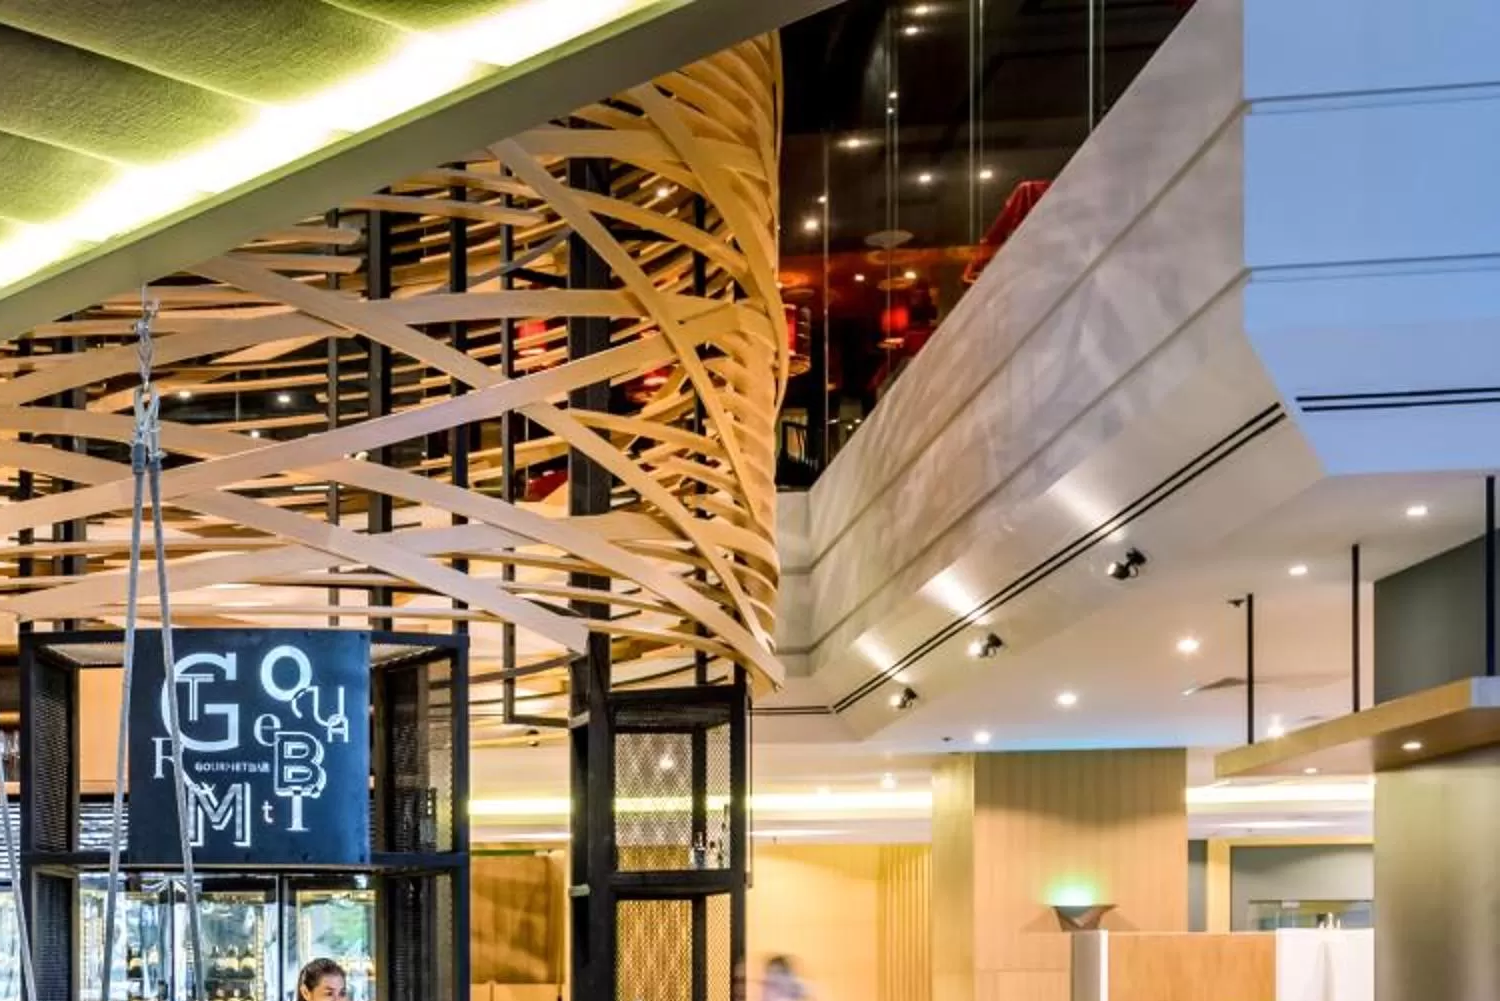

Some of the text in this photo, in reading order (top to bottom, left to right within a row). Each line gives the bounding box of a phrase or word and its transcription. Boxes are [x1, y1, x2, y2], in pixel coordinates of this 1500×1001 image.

[161, 652, 239, 752] G
[174, 673, 215, 721] T
[261, 645, 312, 701] O
[274, 731, 327, 798] B
[184, 782, 251, 847] M
